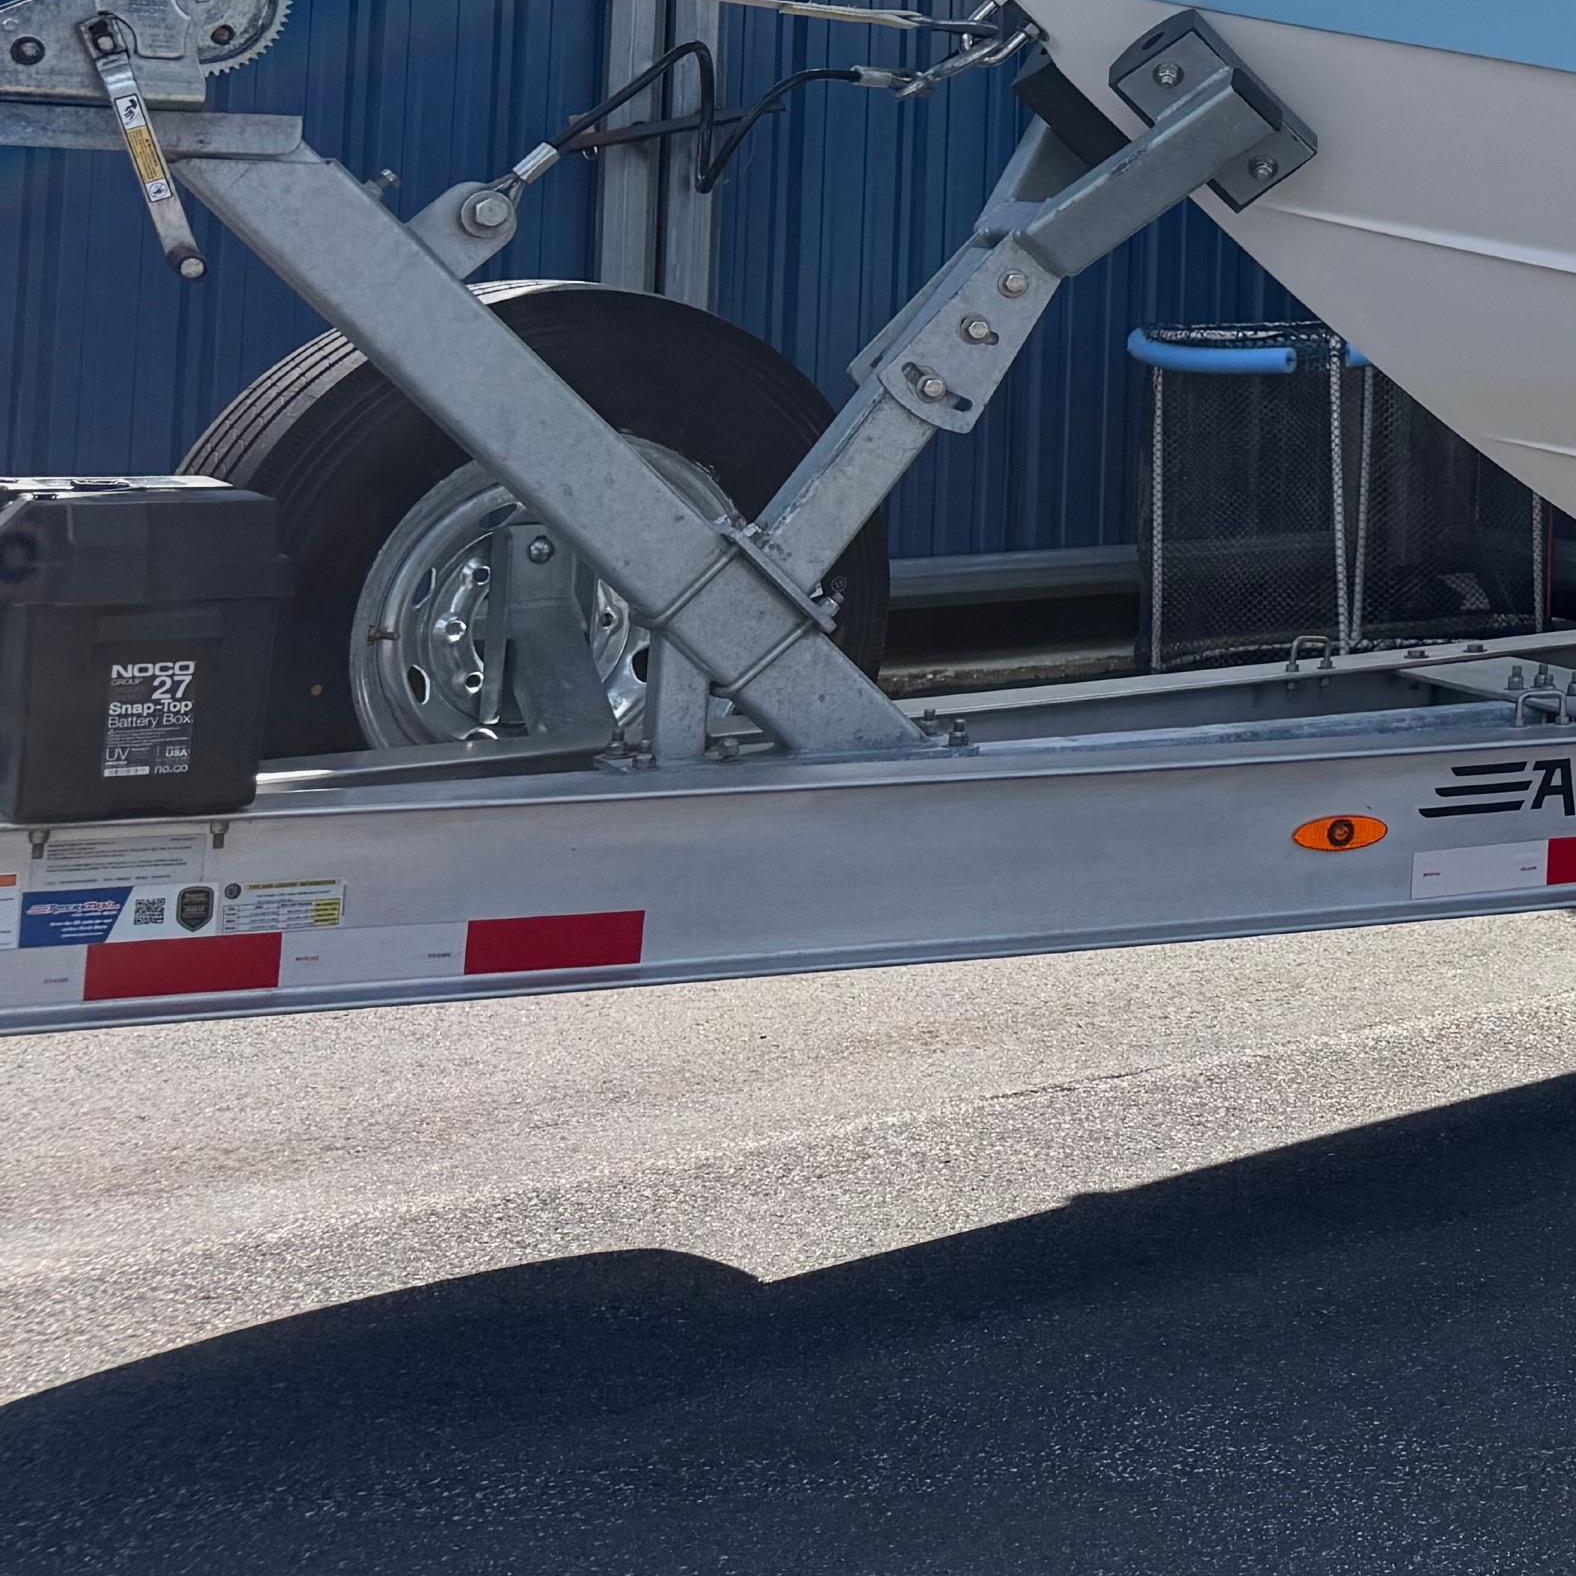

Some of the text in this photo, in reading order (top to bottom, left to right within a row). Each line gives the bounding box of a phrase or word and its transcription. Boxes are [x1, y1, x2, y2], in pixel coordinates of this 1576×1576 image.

[111, 661, 195, 678] NOCO
[151, 675, 193, 699] 27
[108, 699, 193, 716] Snap-Top
[108, 712, 191, 728] Battery Box
[106, 747, 130, 761] UV
